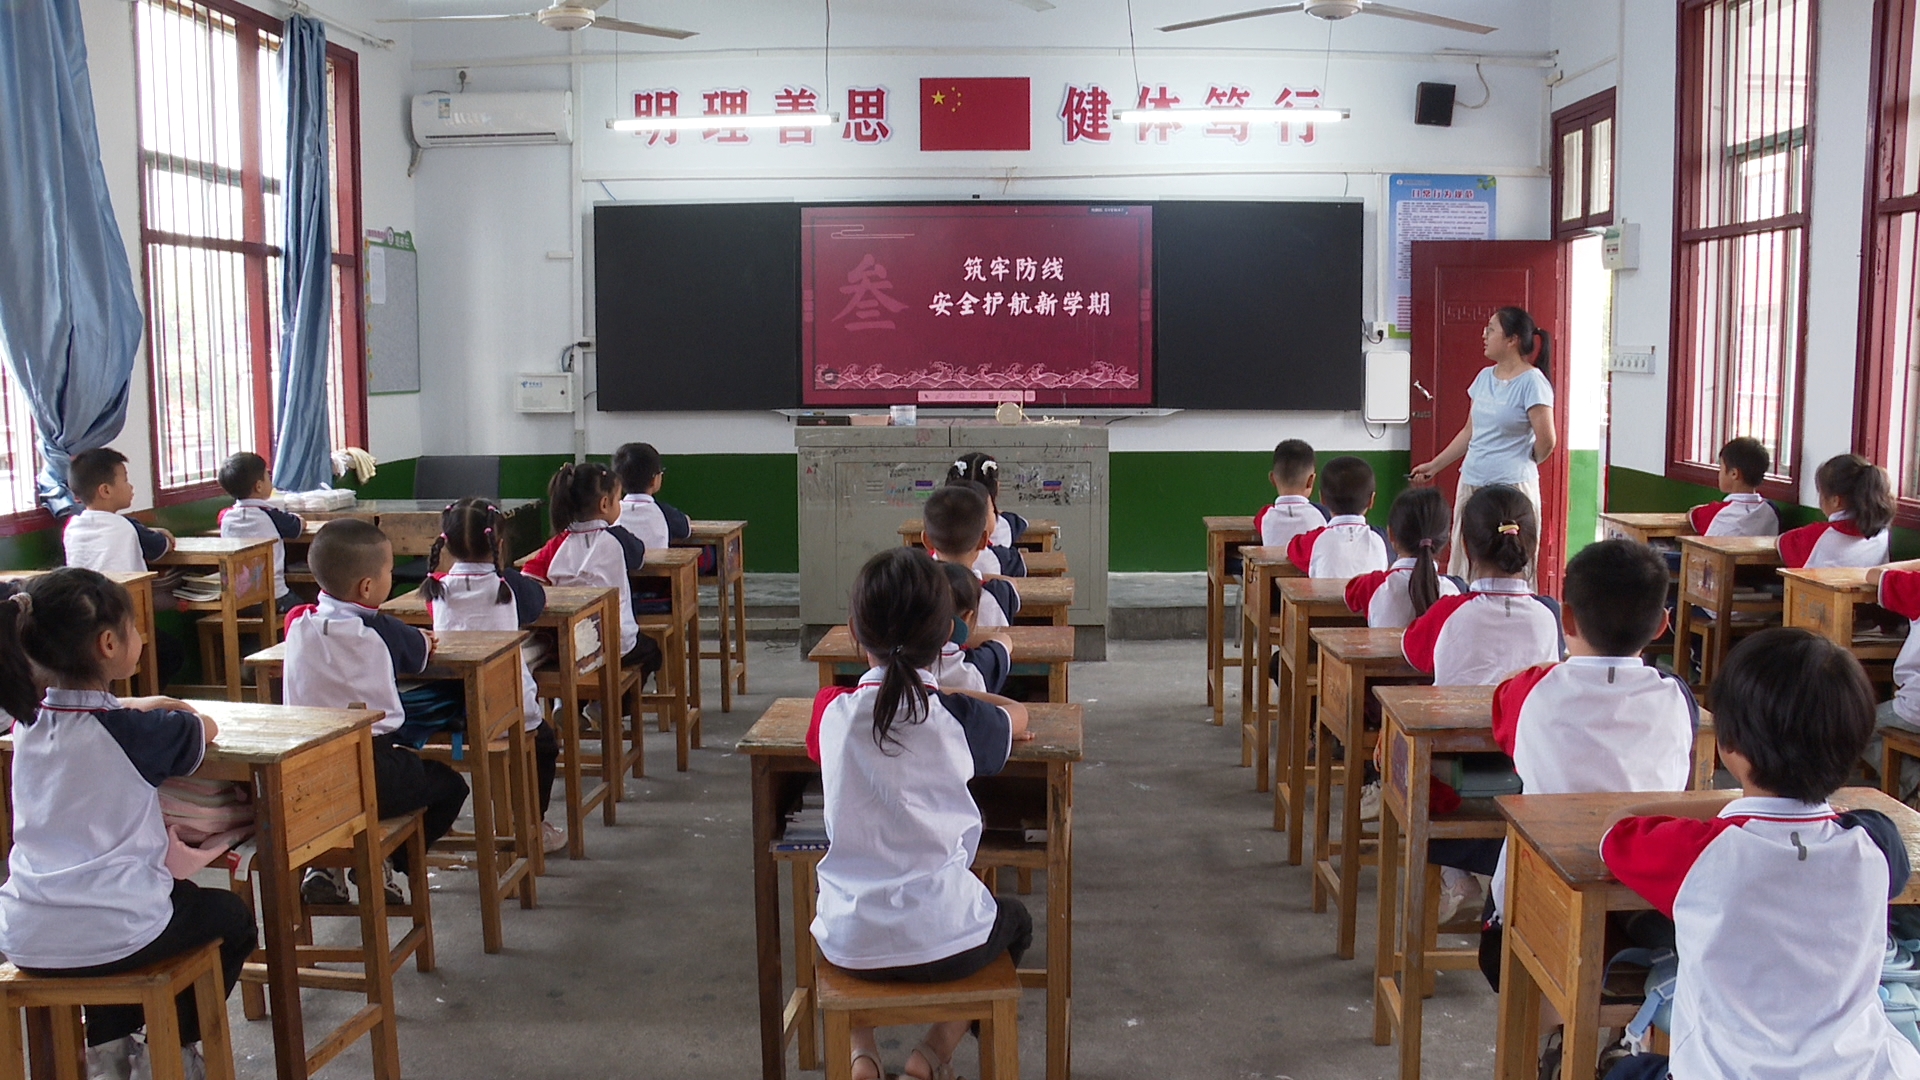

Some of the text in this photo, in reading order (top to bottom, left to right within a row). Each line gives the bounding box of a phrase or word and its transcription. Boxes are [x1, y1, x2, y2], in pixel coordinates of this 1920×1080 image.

[633, 86, 1321, 145] 明理善思 健体笃行
[1411, 189, 1474, 199] 日常行为规范
[963, 256, 1065, 282] 筑牢防线
[831, 254, 910, 332] 叁
[928, 291, 1112, 317] 安全护航新学期
